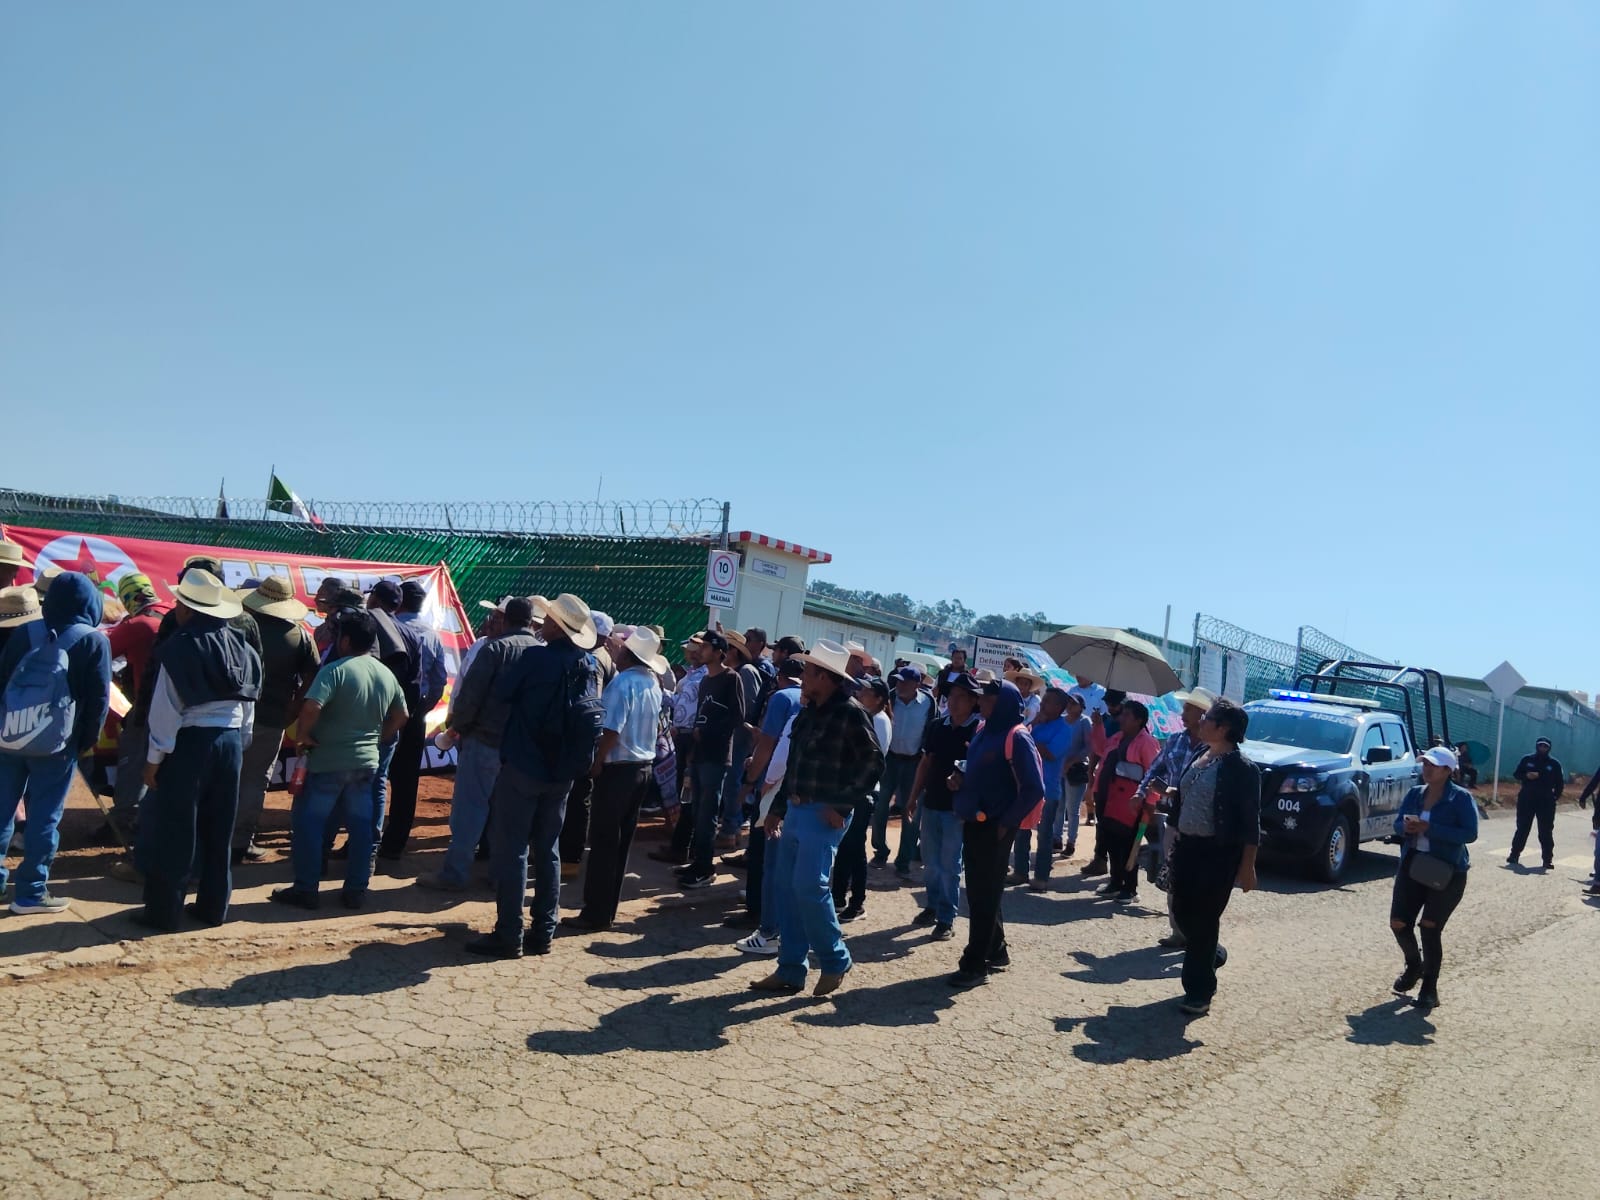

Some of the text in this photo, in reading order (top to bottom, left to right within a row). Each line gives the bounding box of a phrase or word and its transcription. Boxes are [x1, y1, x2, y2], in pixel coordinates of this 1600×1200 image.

[719, 562, 729, 574] 10
[2, 702, 51, 737] NIKE
[1277, 798, 1301, 812] 004
